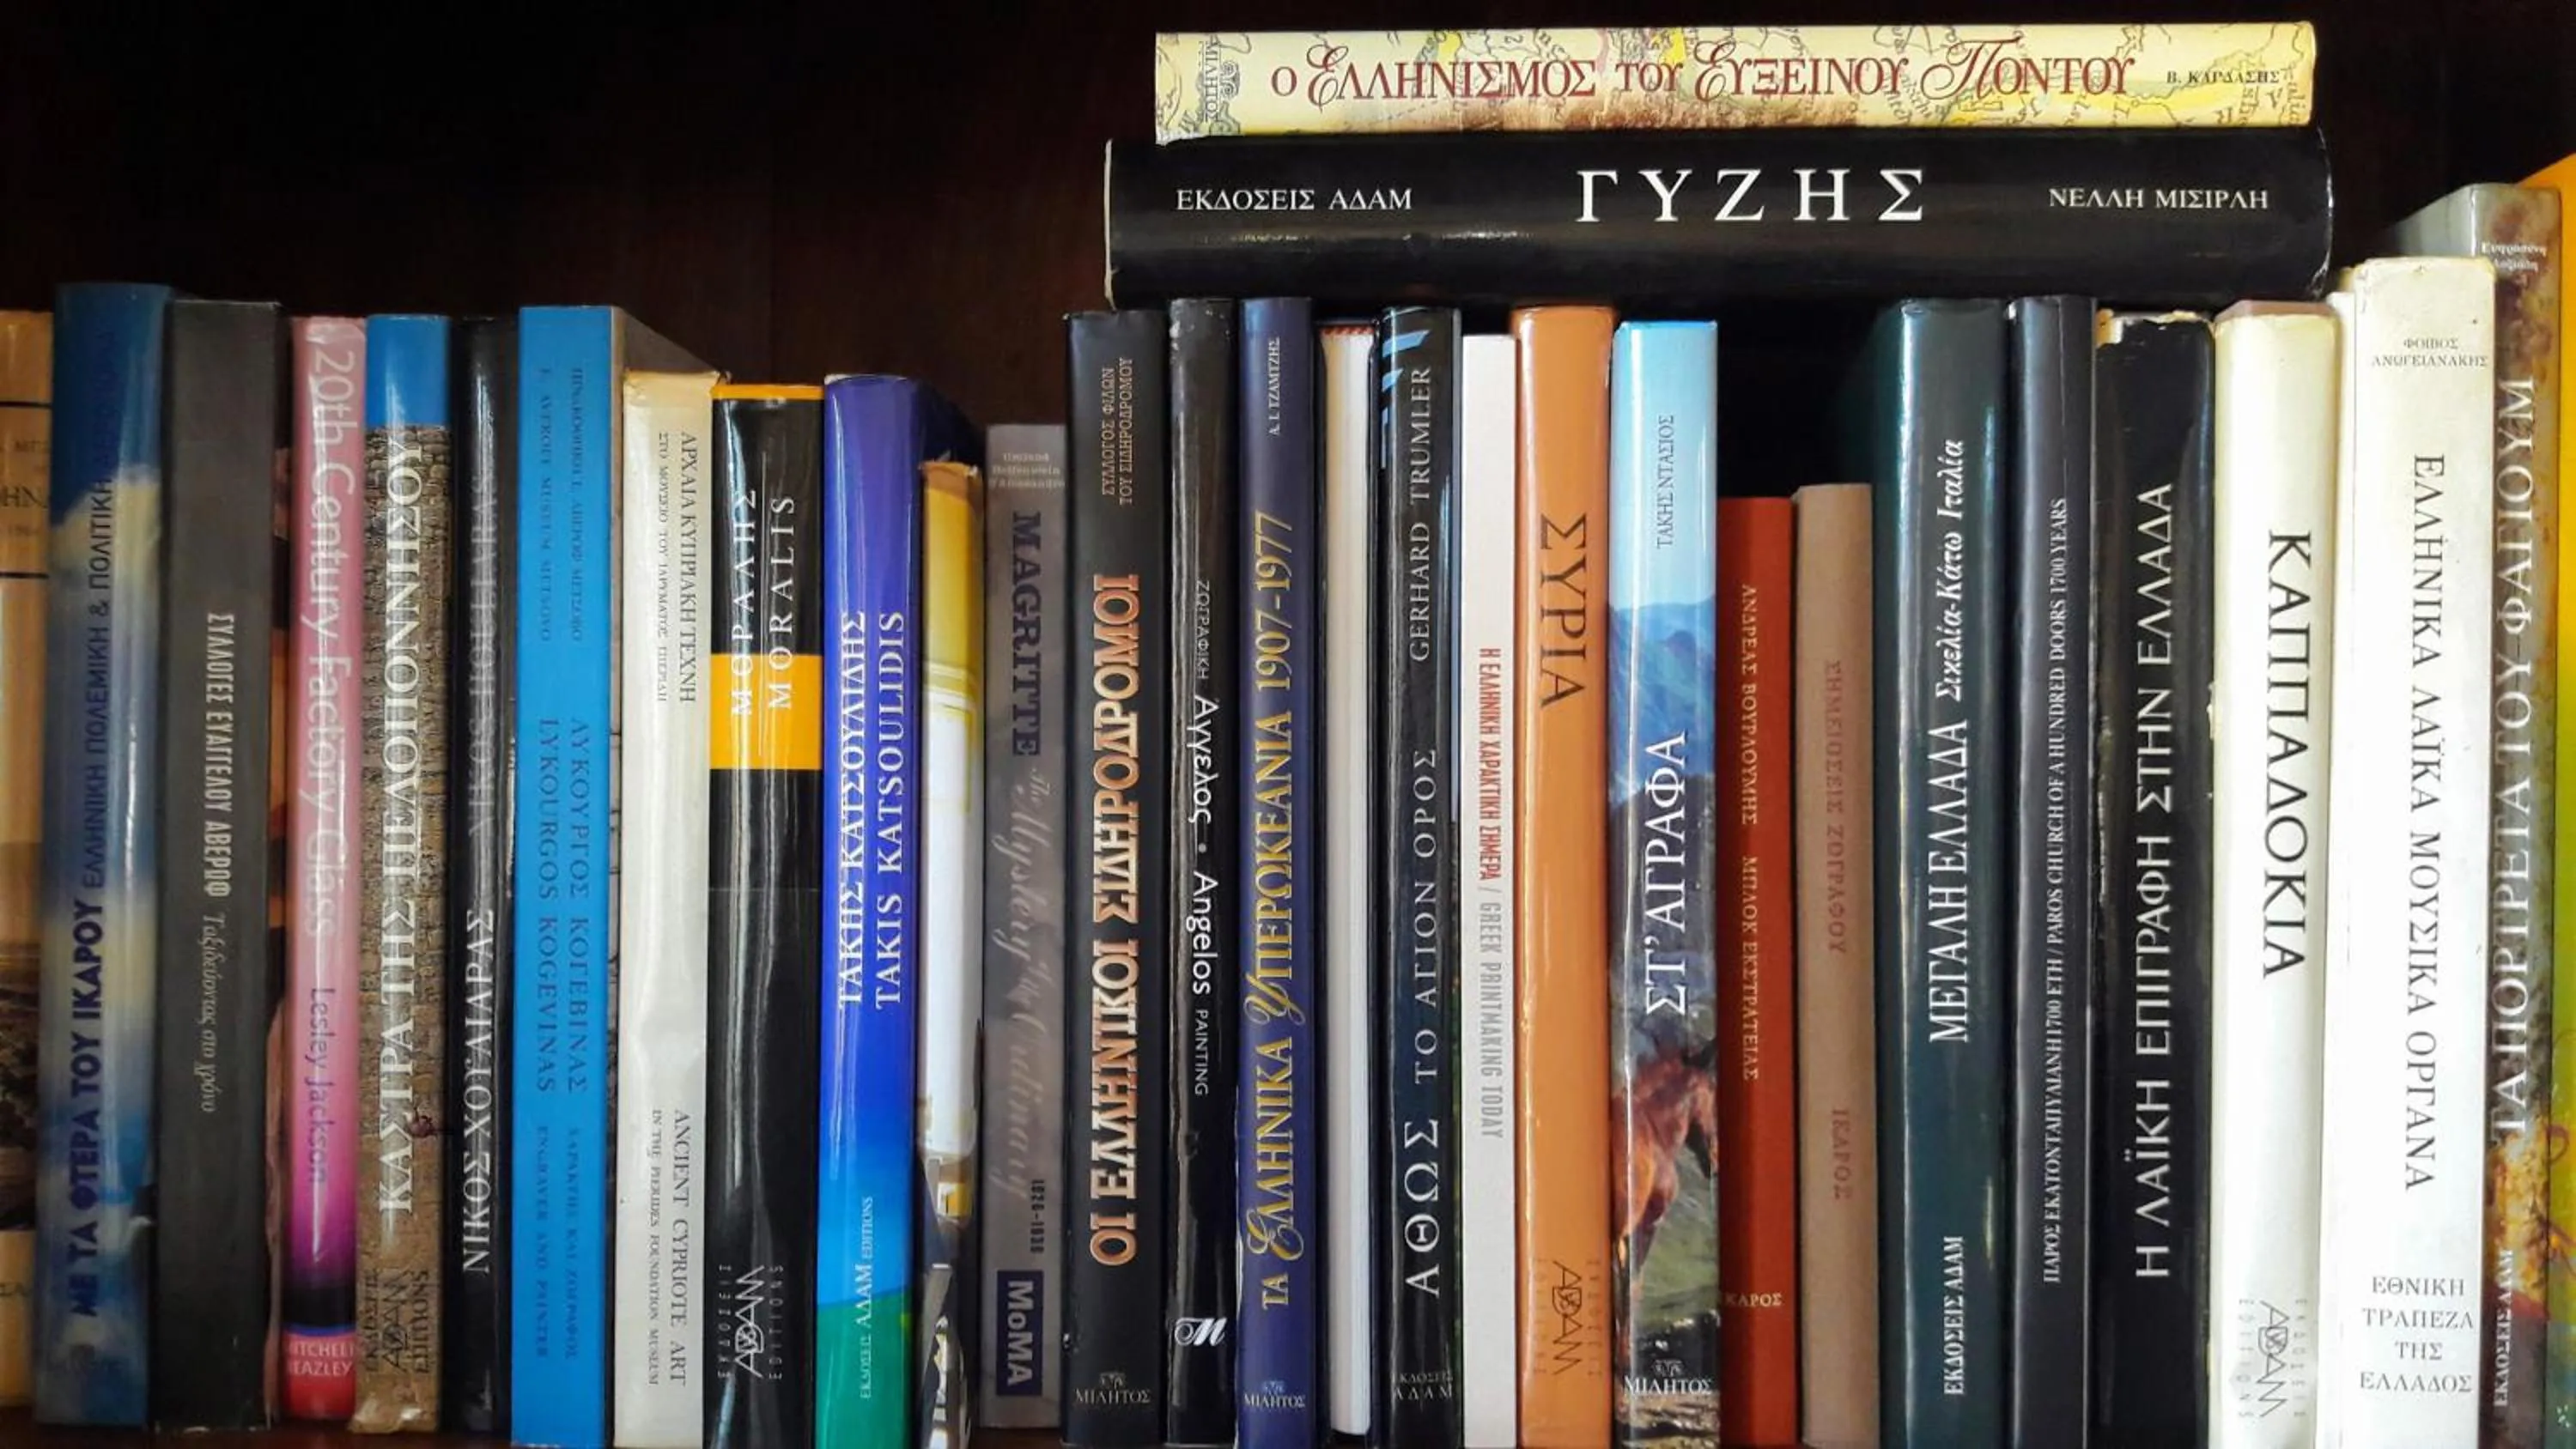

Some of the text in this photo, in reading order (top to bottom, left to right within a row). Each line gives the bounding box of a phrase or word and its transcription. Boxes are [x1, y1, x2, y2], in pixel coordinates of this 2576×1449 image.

[1204, 41, 1219, 122] ΜΙΛΗΤΟΣ
[1271, 66, 1297, 97] Ο
[1306, 45, 1595, 109] ΕΛΛΗΝΙΣΜΟΣ
[1616, 62, 1684, 93] ΤΟΥ
[1695, 41, 1909, 103] ΕΥΞΕΙΝΟΥ
[1920, 36, 2136, 101] ΠΟΝΤΟΥ
[2189, 70, 2281, 84] ΚΑΡΔΑΣΗΣ
[1176, 189, 1413, 211] ΕΚΔΟΣΕΙΣ ΑΔΑΜ
[1576, 169, 1923, 222] ΓΥΖΗΣ
[2049, 188, 2269, 209] ΝΕΛΛΗ ΜΙΣΙΡΛΗ
[1268, 336, 1281, 408] ΤΖΑΜΤΖΗΣ
[2403, 337, 2459, 349] ΦΟΙΒΟΣ
[659, 432, 670, 459] ΣΤΟ
[659, 465, 670, 523] ΜΟΥΣΕΙΟ
[1102, 367, 1115, 495] ΣΥΛΛΟΓΟΣ ΦΙΛΩΝ
[1119, 356, 1133, 506] ΤΟΥ ΣΙΔΗΡΟΔΡΟΜΟΥ
[1656, 414, 1674, 549] ΤΑΚΗΣ ΝΤΑΣΙΟΣ
[88, 478, 112, 590] ΠΟΛΙΤΙΚΗ
[659, 531, 670, 558] ΤΟΥ
[679, 432, 697, 703] ΑΡΧΑΙΑ ΚΥΠΡΙΑΚΗ ΤΕΧΝΗ
[1408, 366, 1432, 662] GERHARD TRUMLER
[89, 602, 109, 615] &
[299, 349, 356, 940] 20th Century Factory Glass
[658, 563, 670, 639] ΙΔΡΥΜΑΤΟΣ
[731, 488, 756, 715] ΜΟΡΑΛΗΣ
[769, 495, 794, 710] MORALIS
[1012, 511, 1041, 757] MAGRITTE
[1196, 579, 1210, 680] ΖΩΓΡΑΦΙΚΗ
[1540, 512, 1587, 708] ΣΥΡΙΑ
[87, 625, 109, 754] ΠΟΛΕΜΙΚΗ
[204, 613, 234, 896] ΣΥΛΛΟΓΕΣ ΕΥΑΓΓΕΛΟΥ ΑΒΕΡΩΦ
[1741, 584, 1758, 825] ΑΝΔΡΕΑΣ ΒΟΥΡΛΟΥΜΗΣ
[1929, 439, 1968, 1045] ΜΕΓΑΛΗ ΕΛΛΑΔΑ Σικελία-Κάτω Ιταλία
[2263, 529, 2312, 979] ΚΑΠΠΑΔΟΚΙΑ
[379, 436, 422, 1214] ΚΑΣΤΡΑ ΤΗΣ ΠΕΛΟΠΟΝΝΗΣΟΥ
[838, 610, 866, 1009] ΤΑΚΗΣ ΚΑΤΣΟΥΛΙΔΗΣ
[875, 611, 904, 1009] TAKIS KATSOULIDIS
[2404, 453, 2445, 1192] ΕΛΛΗΝΙΚΑ ΛΑΪΚΑ ΜΟΥΣΙΚΑ ΟΡΓΑΝΑ
[2490, 376, 2533, 1142] ΤΑ ΠΟΡΤΡΕΤΑ ΤΟΥ ΦΑΓΙΟΥΜ
[81, 764, 106, 889] ΕΛΛΗΝΙΚΗ
[2044, 497, 2068, 1283] ΠΑΡΟΣ ΕΚΑΤΟΝΤΑΠΥΛΙΑΝΗ 1700 ΕΤΗ PAROS CHURCH OF A HUNDRED DOORS 1700 YEARS
[2123, 482, 2172, 1277] Η ΛΑΪΚΗ ΕΠΙΓΡΑΦΗ ΣΤΗΝ ΕΛΛΑΔΑ
[70, 897, 104, 1021] ΙΚΑΡΟΥ
[537, 718, 559, 1094] LYKOURGOS KOGEVINAS
[567, 718, 590, 1094] ΛΥΚΟΥΡΓΟΣ ΚΟΓΕΒΙΝΑΣ
[1091, 573, 1139, 1264] ΟΙ ΕΛΛΗΝΙΚΟΙ ΣΙΔΗΡΟΔΡΟΜΟΙ
[1186, 870, 1219, 995] Angelos
[1242, 508, 1306, 1308] ΤΑ ΕΛΛΗΝΙΚΑ ΥΠΕΡΩΚΕΑΝΙΑ 1907-1977
[1479, 648, 1503, 1139] Η ΕΛΛΗΝΙΚΗ ΧΑΡΑΚΤΙΚΗ ΣΗΜΕΡΑ GREEK PRINTMAKING TODAY
[193, 912, 228, 1113] Ταξιδεύοντας στο χρόνο
[1403, 749, 1440, 1298] ΑΘΩΣ ΤΟ ΑΓΙΟΝ ΟΡΟΣ
[1741, 856, 1759, 1082] ΜΠΛΟΚ ΕΚΣΤΡΑΤΕΙΑΣ
[70, 1033, 102, 1099] ΤΟΥ
[305, 986, 337, 1185] Lesley Jackson
[464, 908, 493, 1273] ΝΙΚΟΣ ΧΟΥΛΙΑΡΑΣ
[1194, 1009, 1210, 1097] PAINTING
[1830, 1108, 1850, 1201] ΙΚΑΡΟΣ
[68, 1221, 100, 1261] ΤΑ
[648, 1109, 662, 1385] IN THE PIERIDES FOUNDATION MUSEUM
[670, 1108, 690, 1387] ANCIENT CYPRIOTE ART
[859, 1196, 873, 1259] EDITIONS
[2372, 1276, 2464, 1297] ΕΘΝΙΚΗ
[769, 1265, 784, 1379] EDITIONS
[1006, 1280, 1034, 1385] MoMA
[1943, 1234, 1965, 1397] ΕΚΔΟΣΕΙΣ ΑΔΑΜ
[2362, 1307, 2474, 1329] ΤΡΑΠΕΖΑ
[2395, 1341, 2443, 1361] ΤΗΣ
[2494, 1249, 2514, 1407] ΕΚΔΟΣΕΙΣ ΑΔΑΜ
[1075, 1388, 1151, 1404] ΜΙΛΗΤΟΣ
[1244, 1392, 1306, 1409] ΜΙΛΗΤΟΣ
[1624, 1375, 1712, 1396] ΜΙΛΗΤΟΣ
[2360, 1372, 2472, 1392] ΕΛΛΑΔΟΣ
